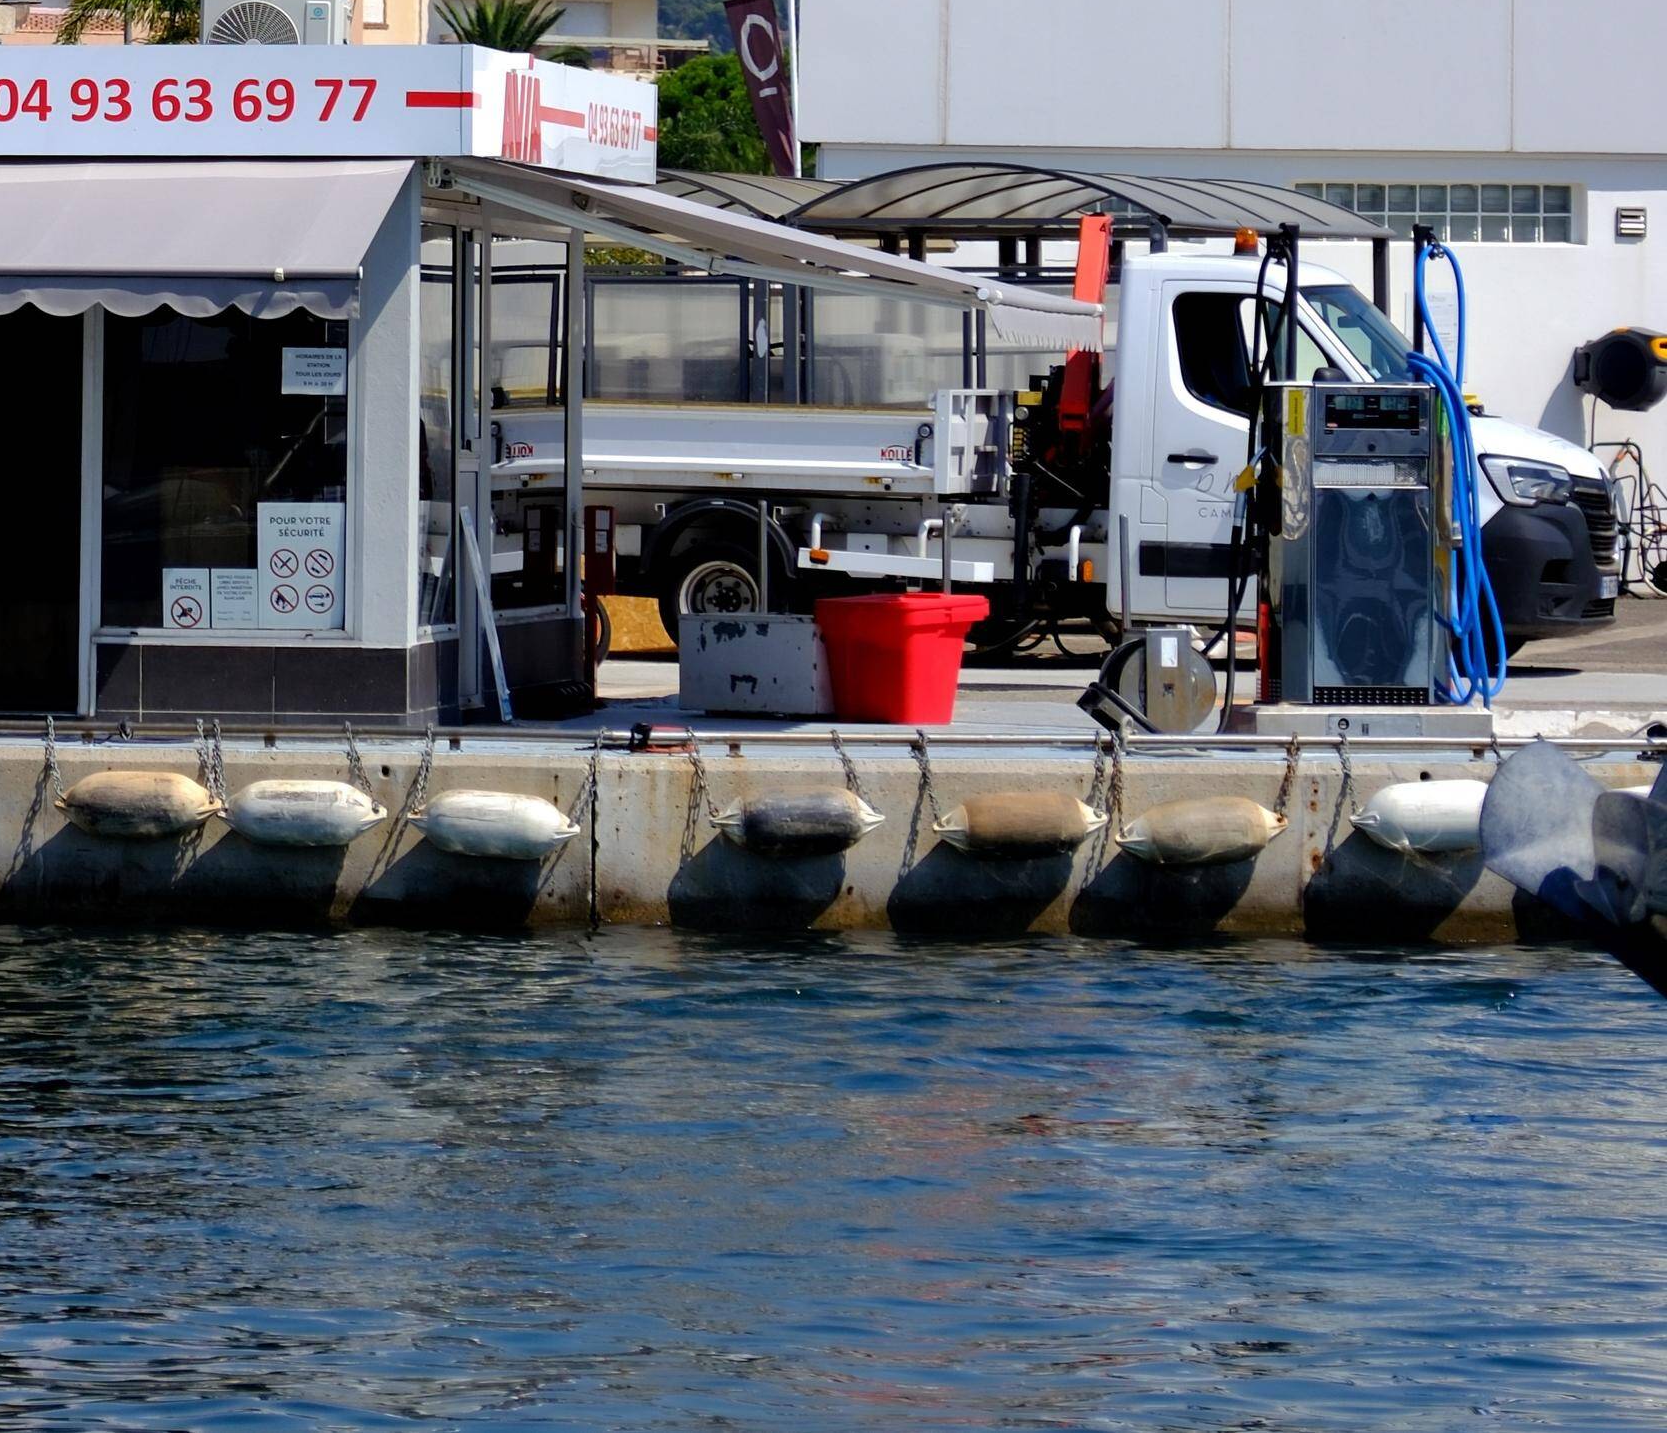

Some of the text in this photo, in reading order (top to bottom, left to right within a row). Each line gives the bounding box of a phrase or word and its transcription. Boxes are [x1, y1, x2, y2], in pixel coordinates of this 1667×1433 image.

[70, 78, 132, 122] 93
[151, 78, 213, 122] 63
[232, 78, 295, 122] 69
[314, 78, 377, 122] 77
[588, 102, 641, 151] 04 93 63 69 77
[269, 517, 331, 525] POUR VOTRE
[278, 527, 325, 537] SÉCURITÉ
